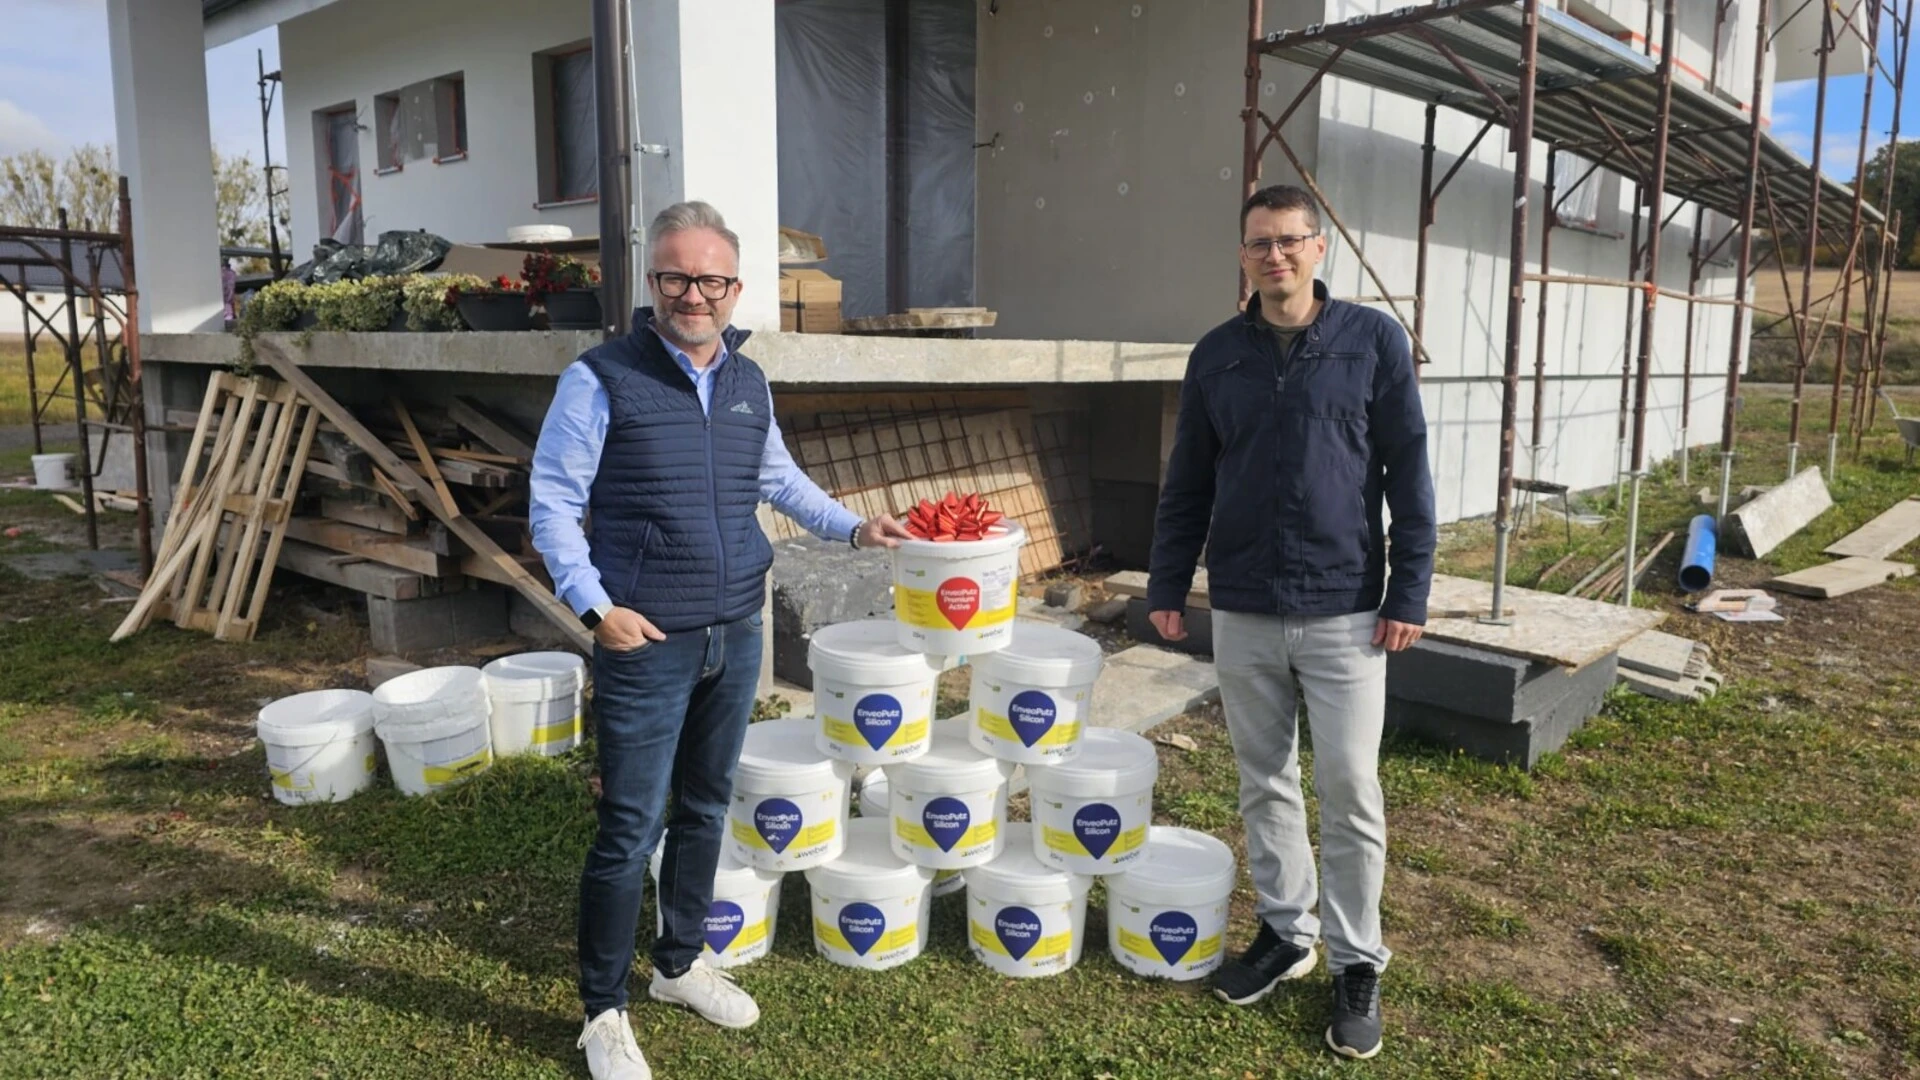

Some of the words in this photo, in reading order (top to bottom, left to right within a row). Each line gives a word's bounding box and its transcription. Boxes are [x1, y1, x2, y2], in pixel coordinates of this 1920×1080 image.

[941, 588, 978, 597] EnveoPutz
[944, 595, 975, 604] Premium
[948, 603, 971, 611] Active
[857, 708, 900, 718] EnveoPutz
[1012, 704, 1054, 717] EnveoPutz
[865, 718, 892, 727] Silicon
[1018, 713, 1045, 724] Silicon
[756, 812, 800, 822] EnveoPutz
[925, 811, 968, 821] EnveoPutz
[764, 820, 791, 830] Silicon
[933, 820, 960, 829] Silicon
[1076, 818, 1119, 828] EnveoPutz
[1084, 827, 1111, 835] Silicon
[801, 844, 829, 859] weber
[703, 914, 742, 925] nveoPutz
[841, 915, 883, 926] EnveoPutz
[997, 918, 1039, 931] EnveoPutz
[707, 923, 734, 932] Silicon
[848, 925, 875, 934] Silicon
[1004, 927, 1031, 938] Silicon
[1152, 924, 1196, 935] EnveoPutz
[1160, 933, 1187, 943] Silicon
